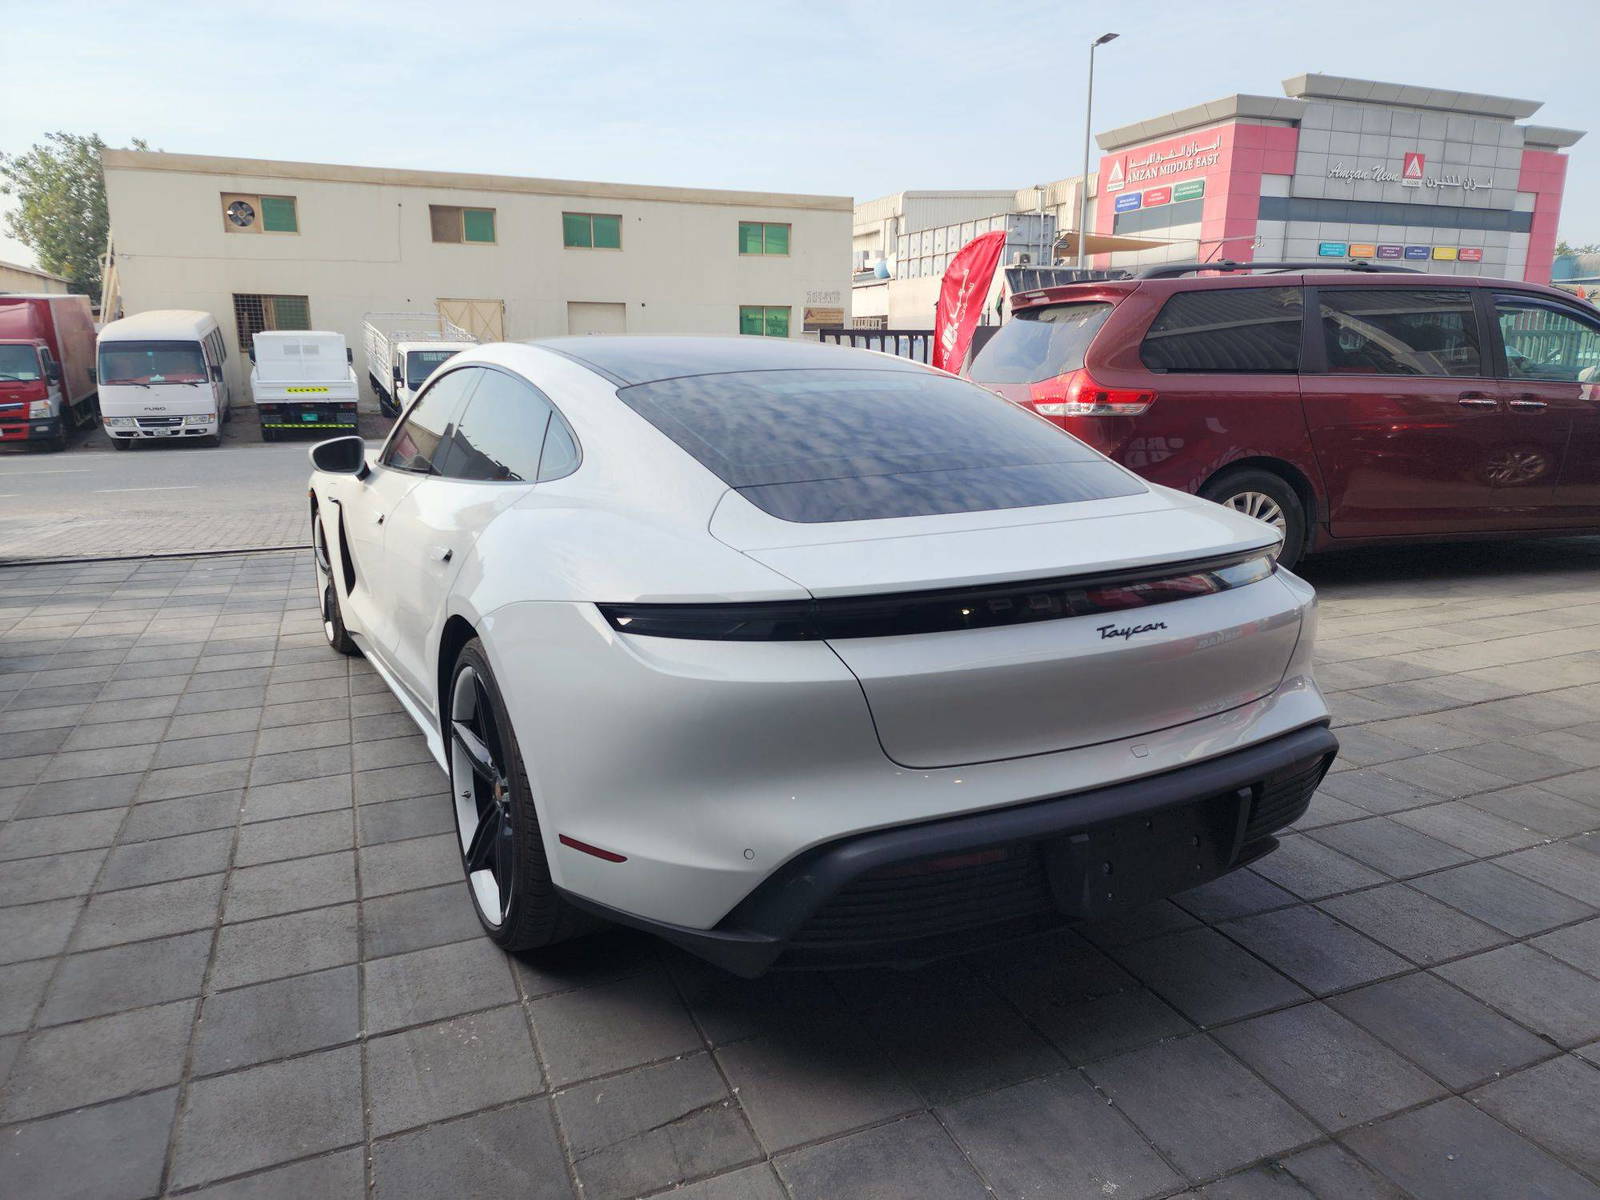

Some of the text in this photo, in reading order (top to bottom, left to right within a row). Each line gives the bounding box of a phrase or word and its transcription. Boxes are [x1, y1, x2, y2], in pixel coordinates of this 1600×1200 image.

[1127, 153, 1219, 184] AMZAN MIDDLE EAST
[1328, 160, 1401, 184] Amzan Neon
[1096, 622, 1168, 640] Taycan
